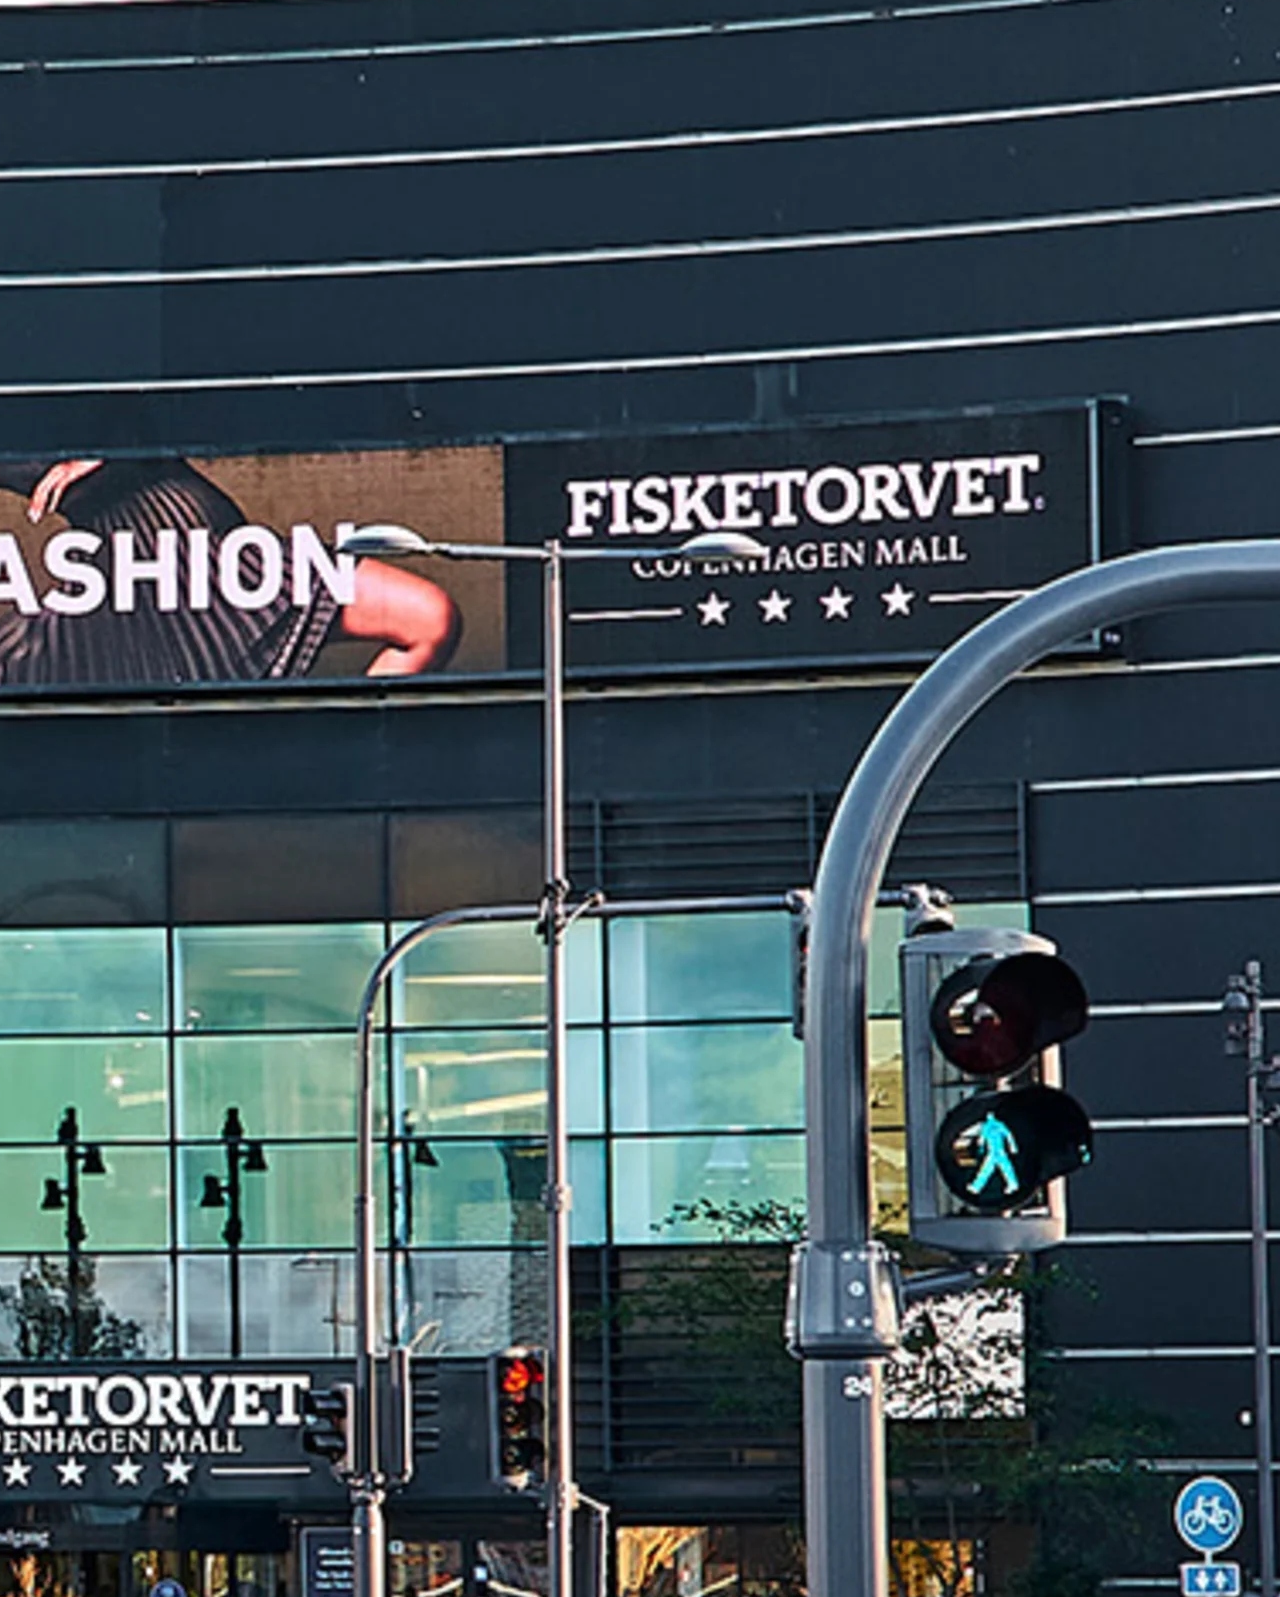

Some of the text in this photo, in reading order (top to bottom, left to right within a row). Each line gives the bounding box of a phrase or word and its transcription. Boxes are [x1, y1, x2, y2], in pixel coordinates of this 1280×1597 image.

[566, 454, 1039, 536] FISKETORVET
[874, 535, 967, 566] MALL
[160, 1429, 243, 1454] MALL
